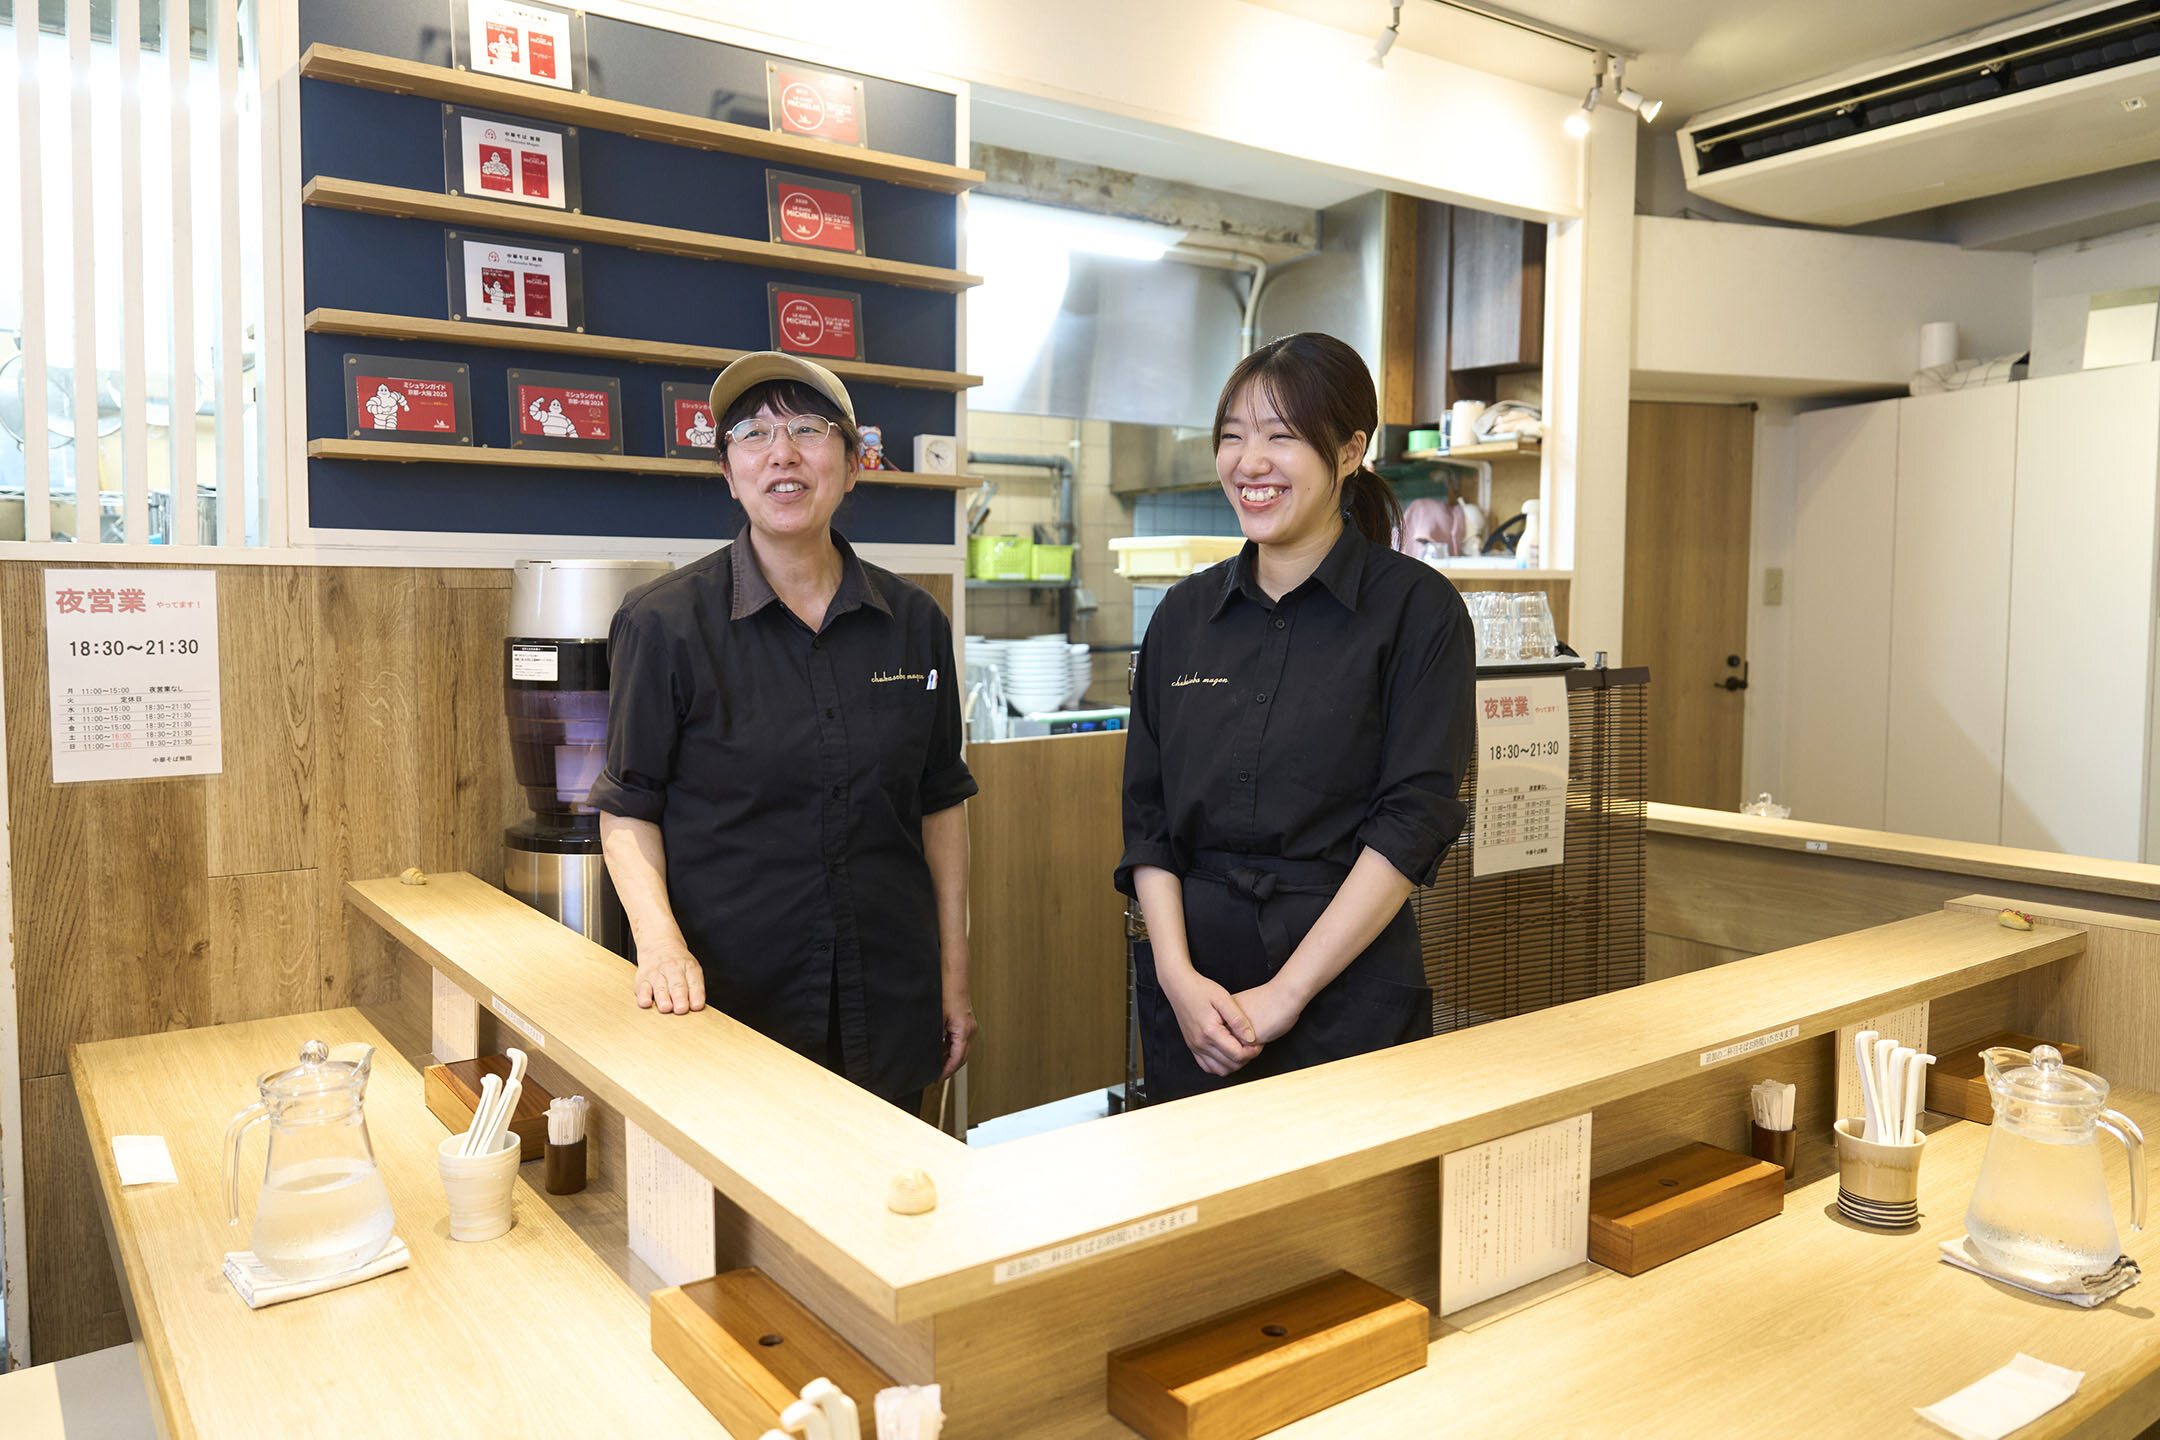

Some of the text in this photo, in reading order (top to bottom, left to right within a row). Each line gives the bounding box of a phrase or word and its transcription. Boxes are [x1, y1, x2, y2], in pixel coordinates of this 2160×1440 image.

[786, 209, 819, 221] MICHELIN
[786, 316, 819, 327] MICHELIN
[404, 382, 446, 390] ミシュランガイド
[565, 391, 603, 400] ミシュランガイド
[56, 588, 146, 614] 夜営業
[1484, 696, 1529, 719] 夜営業
